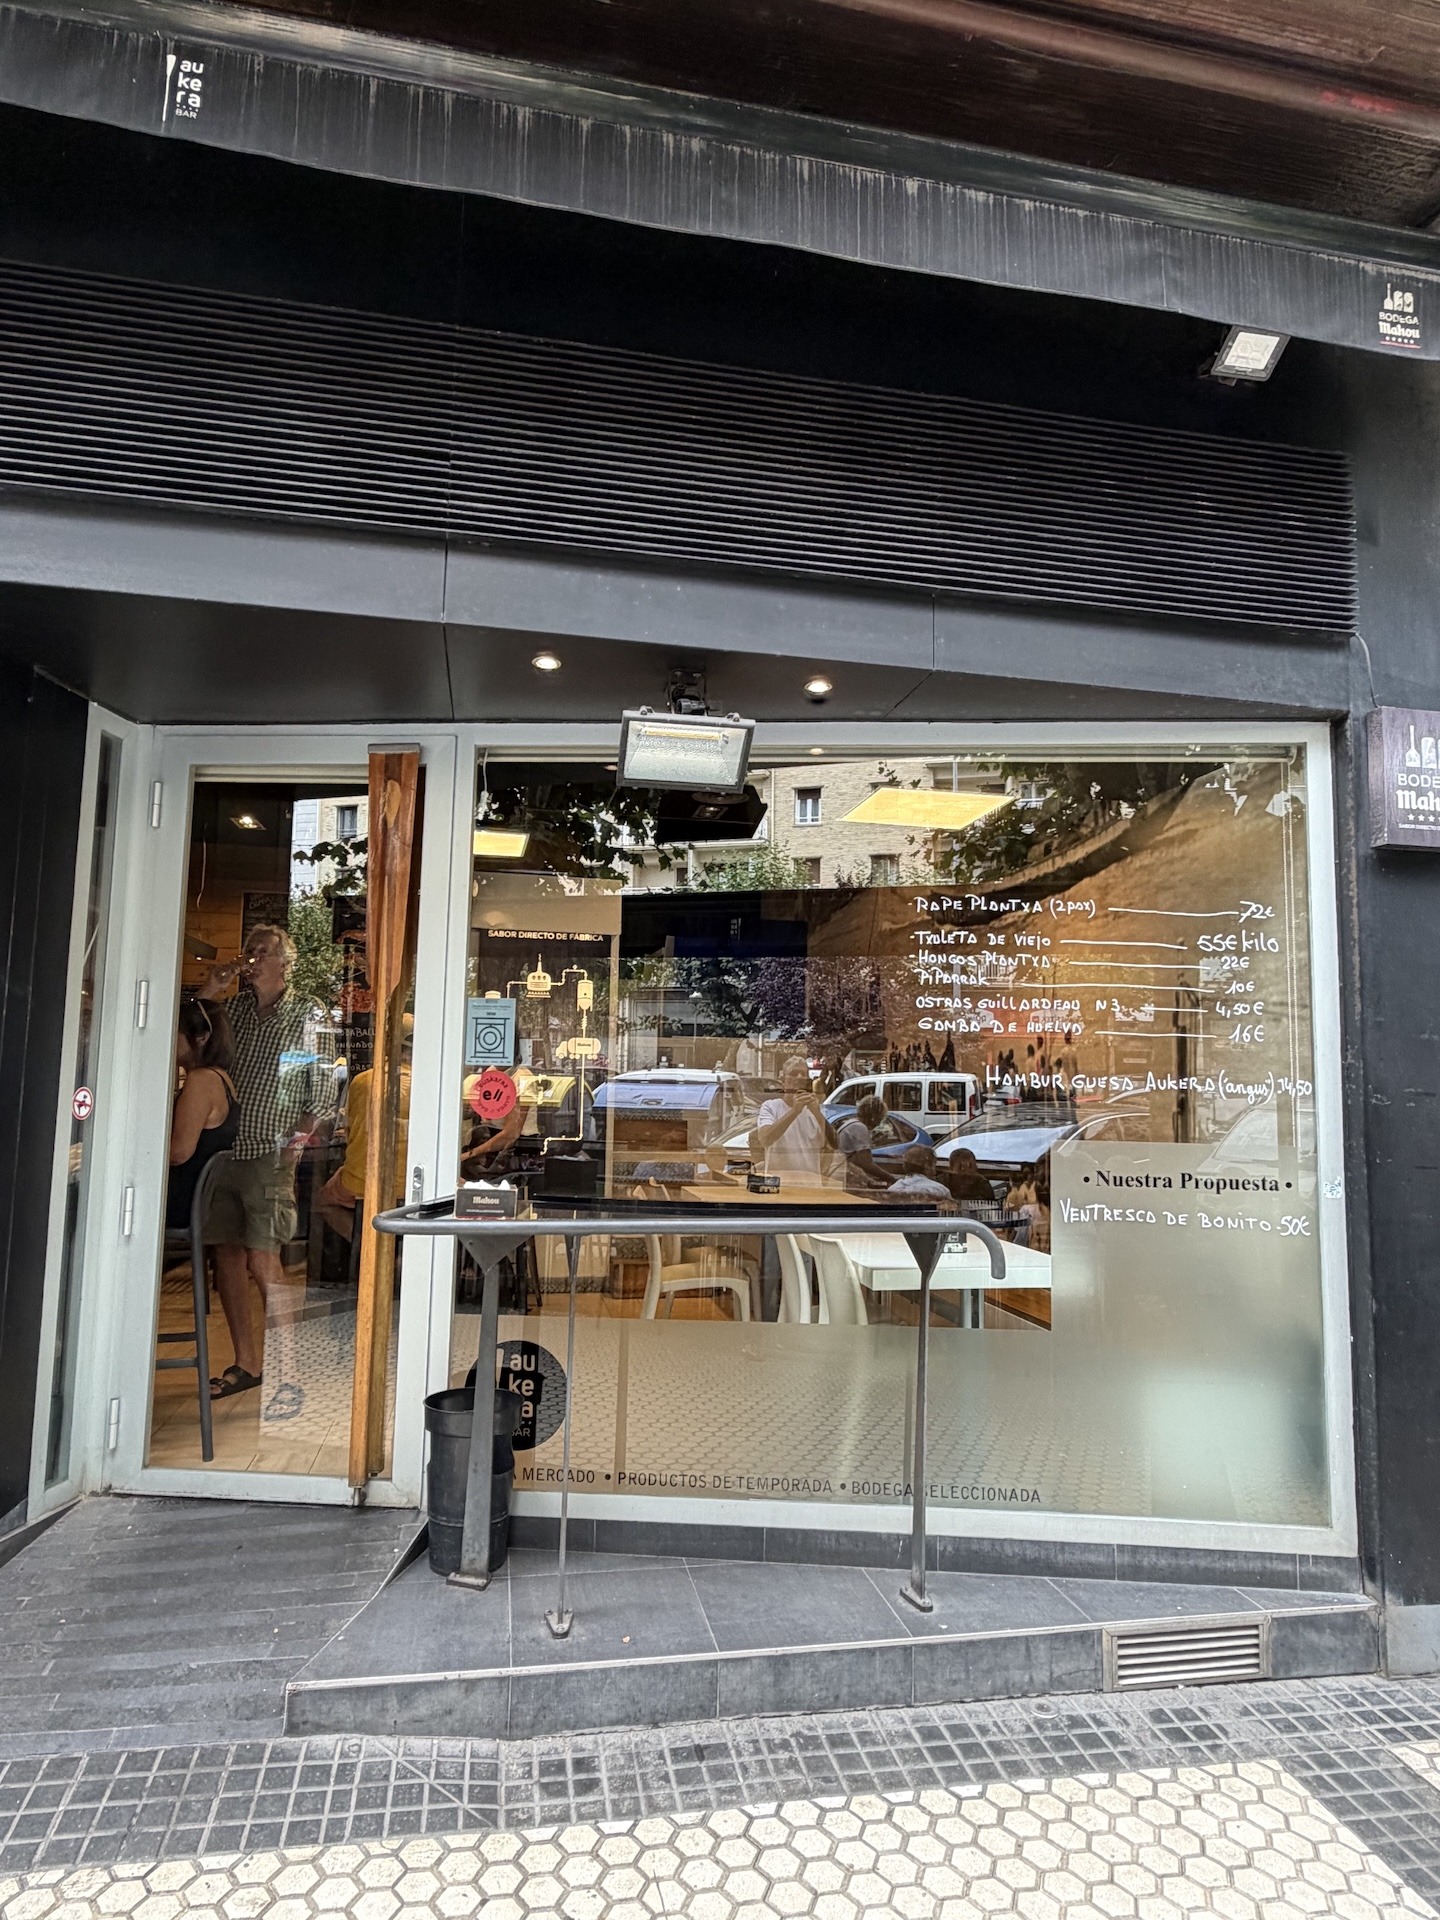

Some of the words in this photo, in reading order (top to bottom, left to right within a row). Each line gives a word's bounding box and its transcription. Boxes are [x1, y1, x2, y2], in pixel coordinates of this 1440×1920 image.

[180, 60, 204, 74] au
[178, 72, 202, 91] ke
[176, 91, 200, 108] ra
[175, 108, 198, 119] BAR
[1378, 312, 1419, 325] BODEGA
[1378, 321, 1420, 339] Mahou
[1239, 900, 1276, 923] 72€
[488, 930, 517, 938] SABOR
[518, 931, 555, 940] DIRECTO
[556, 933, 568, 941] DE
[569, 932, 604, 942] FÁBRICA
[987, 933, 1006, 946] DE
[1220, 956, 1250, 970] 22€
[1224, 980, 1256, 995] 10€
[916, 997, 973, 1010] OSTRAS
[918, 1017, 981, 1034] GAMBA
[990, 1020, 1017, 1034] DE
[1027, 1021, 1082, 1036] HUELVA
[1228, 1023, 1265, 1042] 16€
[1096, 1170, 1173, 1189] Nuestra
[1180, 1172, 1280, 1194] Propuesta
[1060, 1198, 1157, 1224] VENTRESCA
[1163, 1211, 1189, 1226] DE
[510, 1354, 536, 1372] au
[522, 1467, 595, 1484] MERCADO
[618, 1471, 707, 1488] PRODUCTOS
[712, 1475, 732, 1488] DE
[738, 1476, 833, 1493] TEMPORADA
[852, 1480, 914, 1496] BODEGA
